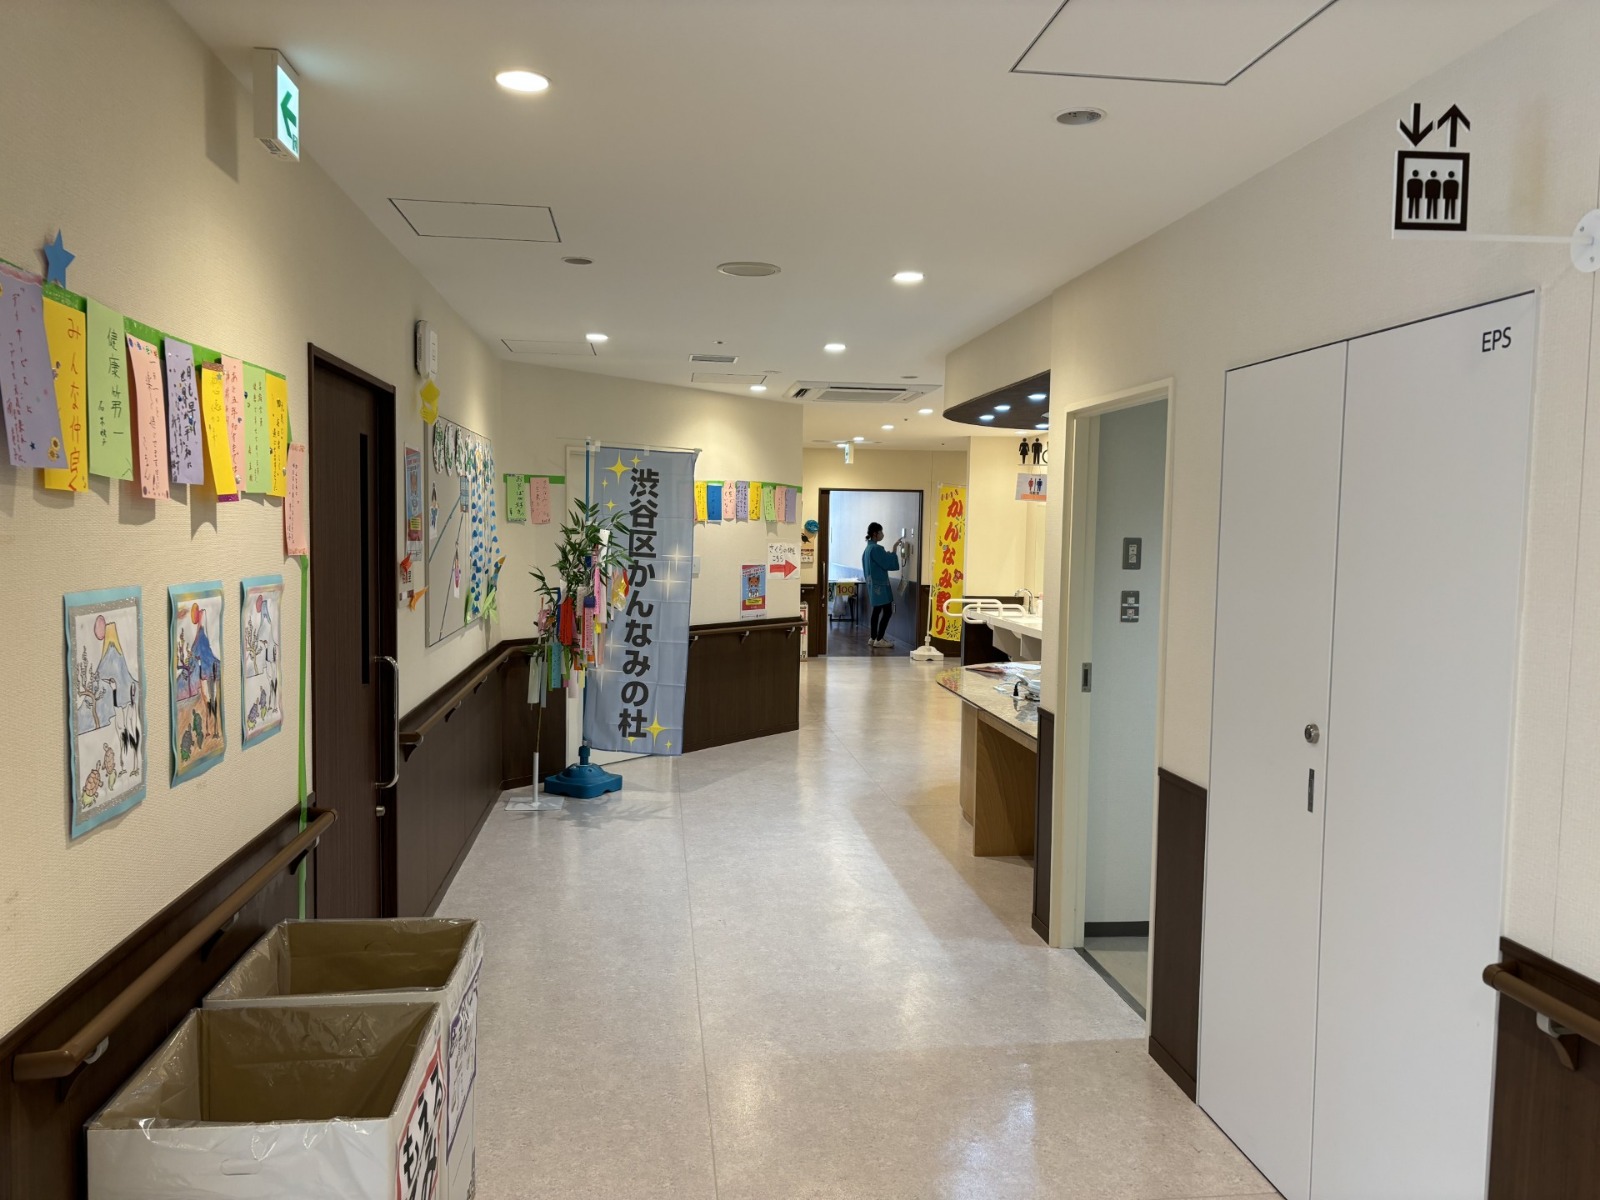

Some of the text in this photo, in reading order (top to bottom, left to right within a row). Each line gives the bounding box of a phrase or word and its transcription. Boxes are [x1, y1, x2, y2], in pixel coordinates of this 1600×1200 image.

[67, 316, 82, 491] みんな仲良く
[107, 326, 125, 436] 健康第一
[1481, 326, 1512, 353] EPS
[617, 467, 661, 739] 渋谷区かんなみの杜
[935, 498, 964, 636] かんなみ祭り
